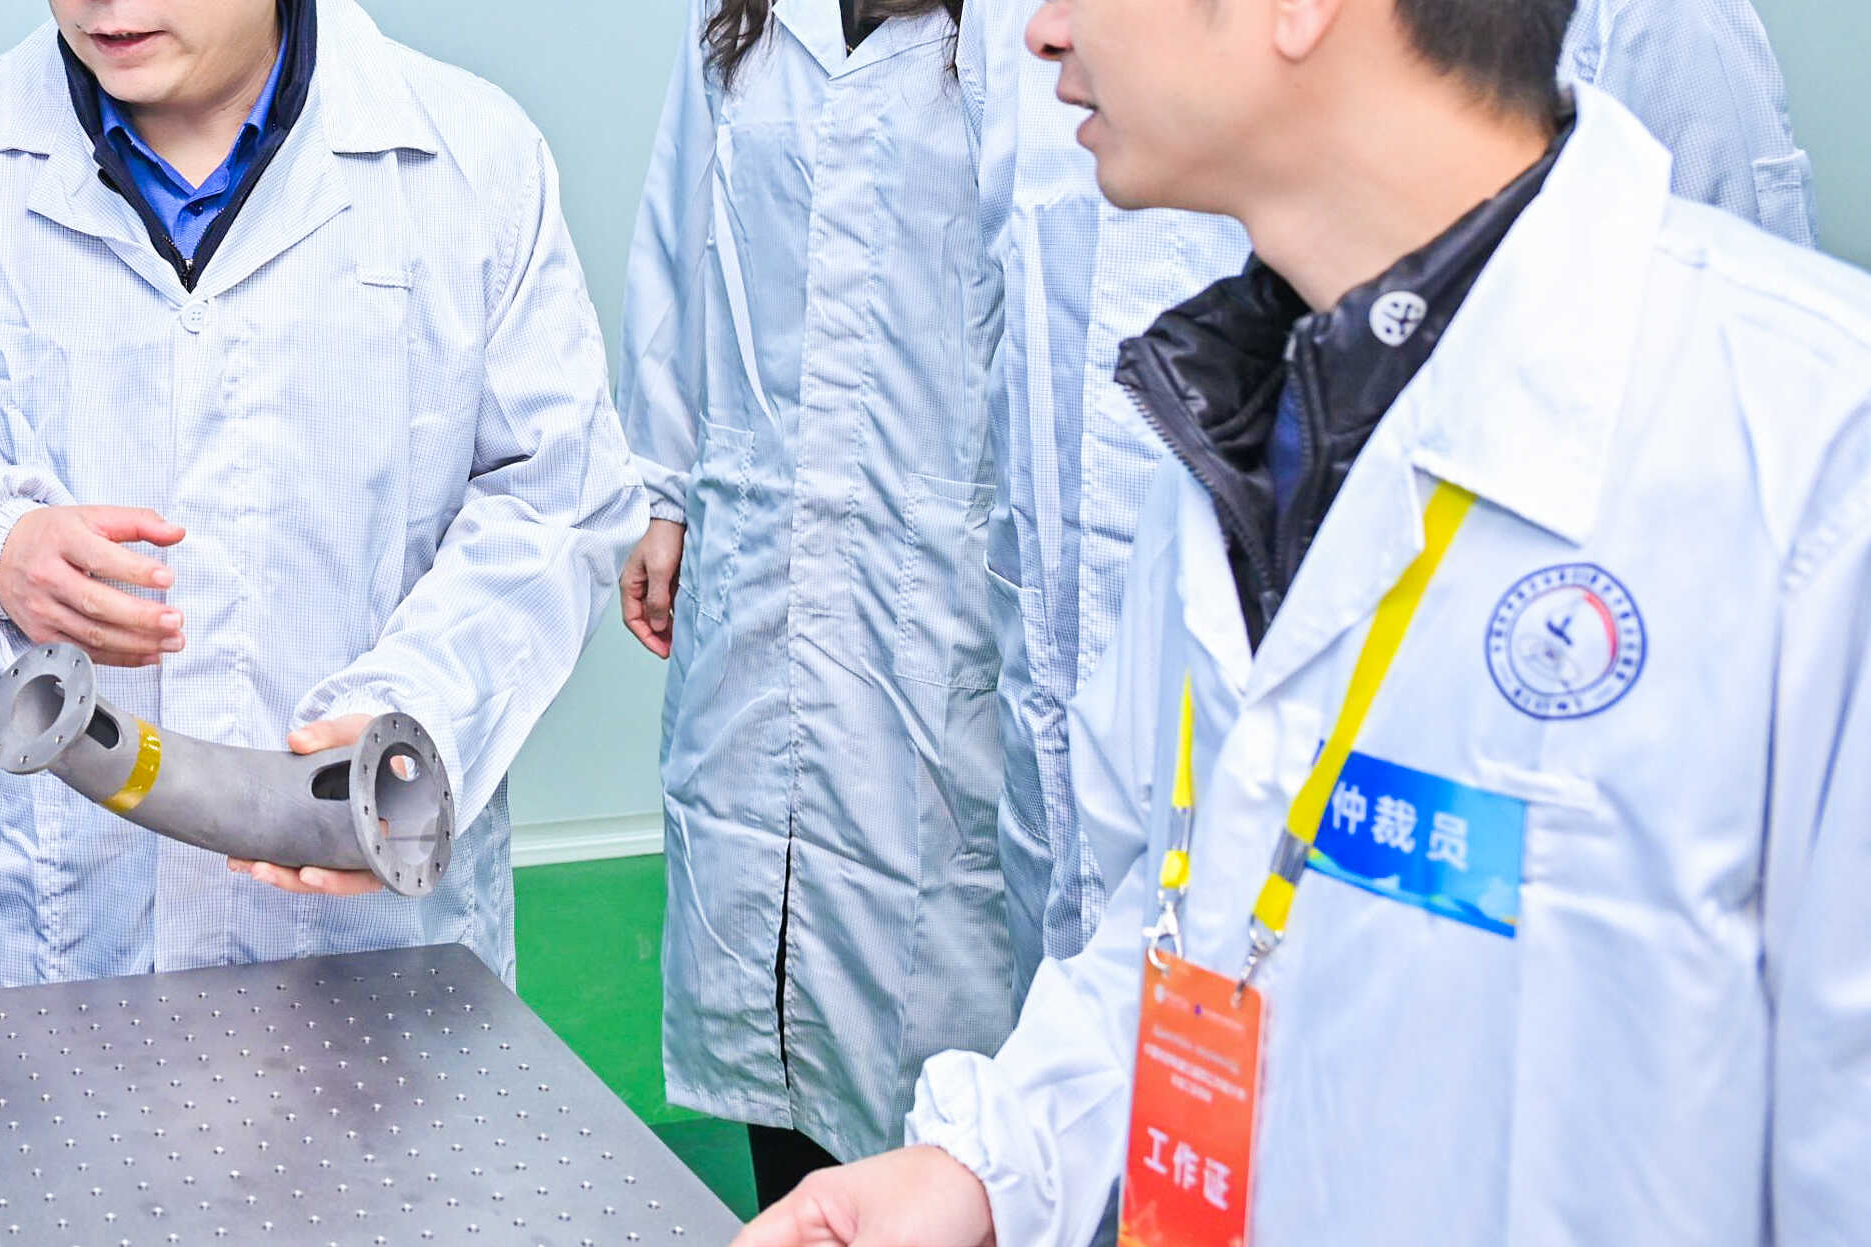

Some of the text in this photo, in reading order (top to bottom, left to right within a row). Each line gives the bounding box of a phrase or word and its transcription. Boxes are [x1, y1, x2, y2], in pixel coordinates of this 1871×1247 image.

[1332, 781, 1468, 872] 仲裁员
[1143, 1126, 1231, 1211] 工作证
